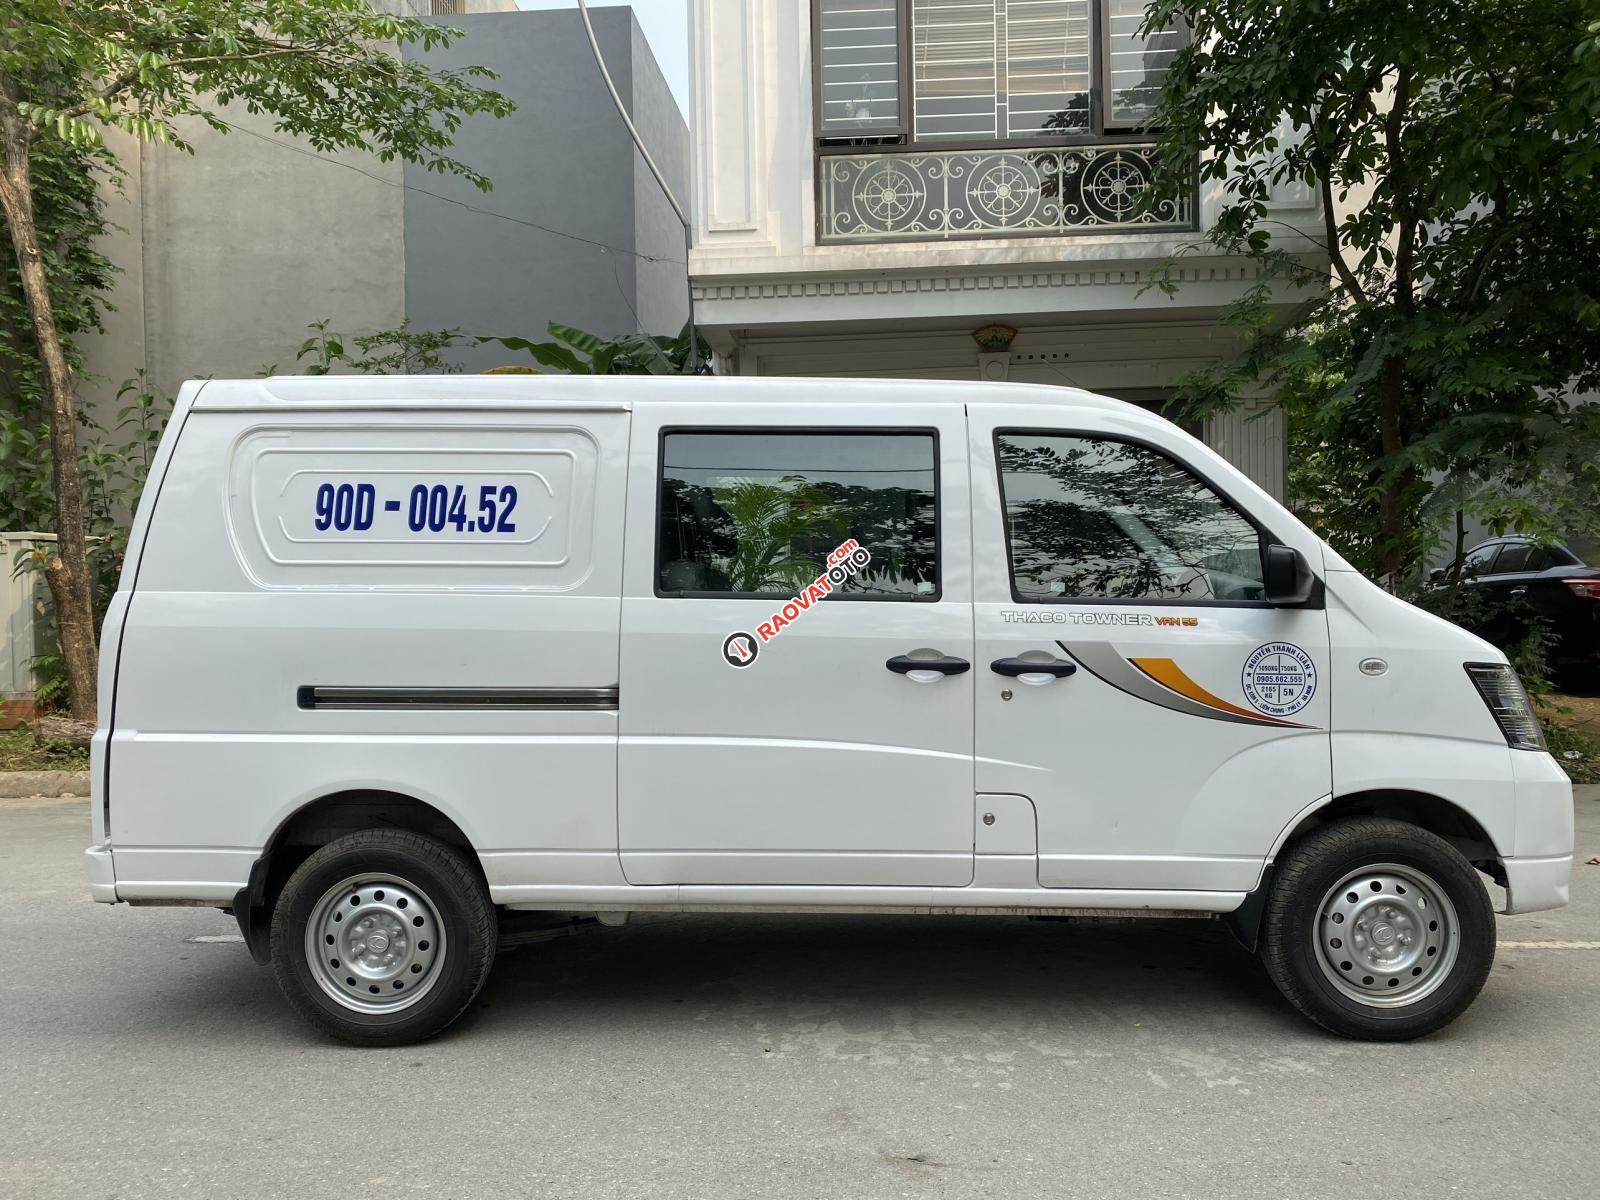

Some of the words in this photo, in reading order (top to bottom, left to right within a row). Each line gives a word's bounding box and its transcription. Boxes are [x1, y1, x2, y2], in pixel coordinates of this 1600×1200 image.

[314, 483, 375, 531] 90D
[385, 500, 400, 511] -
[408, 484, 518, 532] 004.52
[1001, 611, 1066, 623] THACO
[1069, 613, 1153, 626] TOWNER
[1154, 616, 1180, 626] VAN
[1283, 688, 1294, 696] 5N
